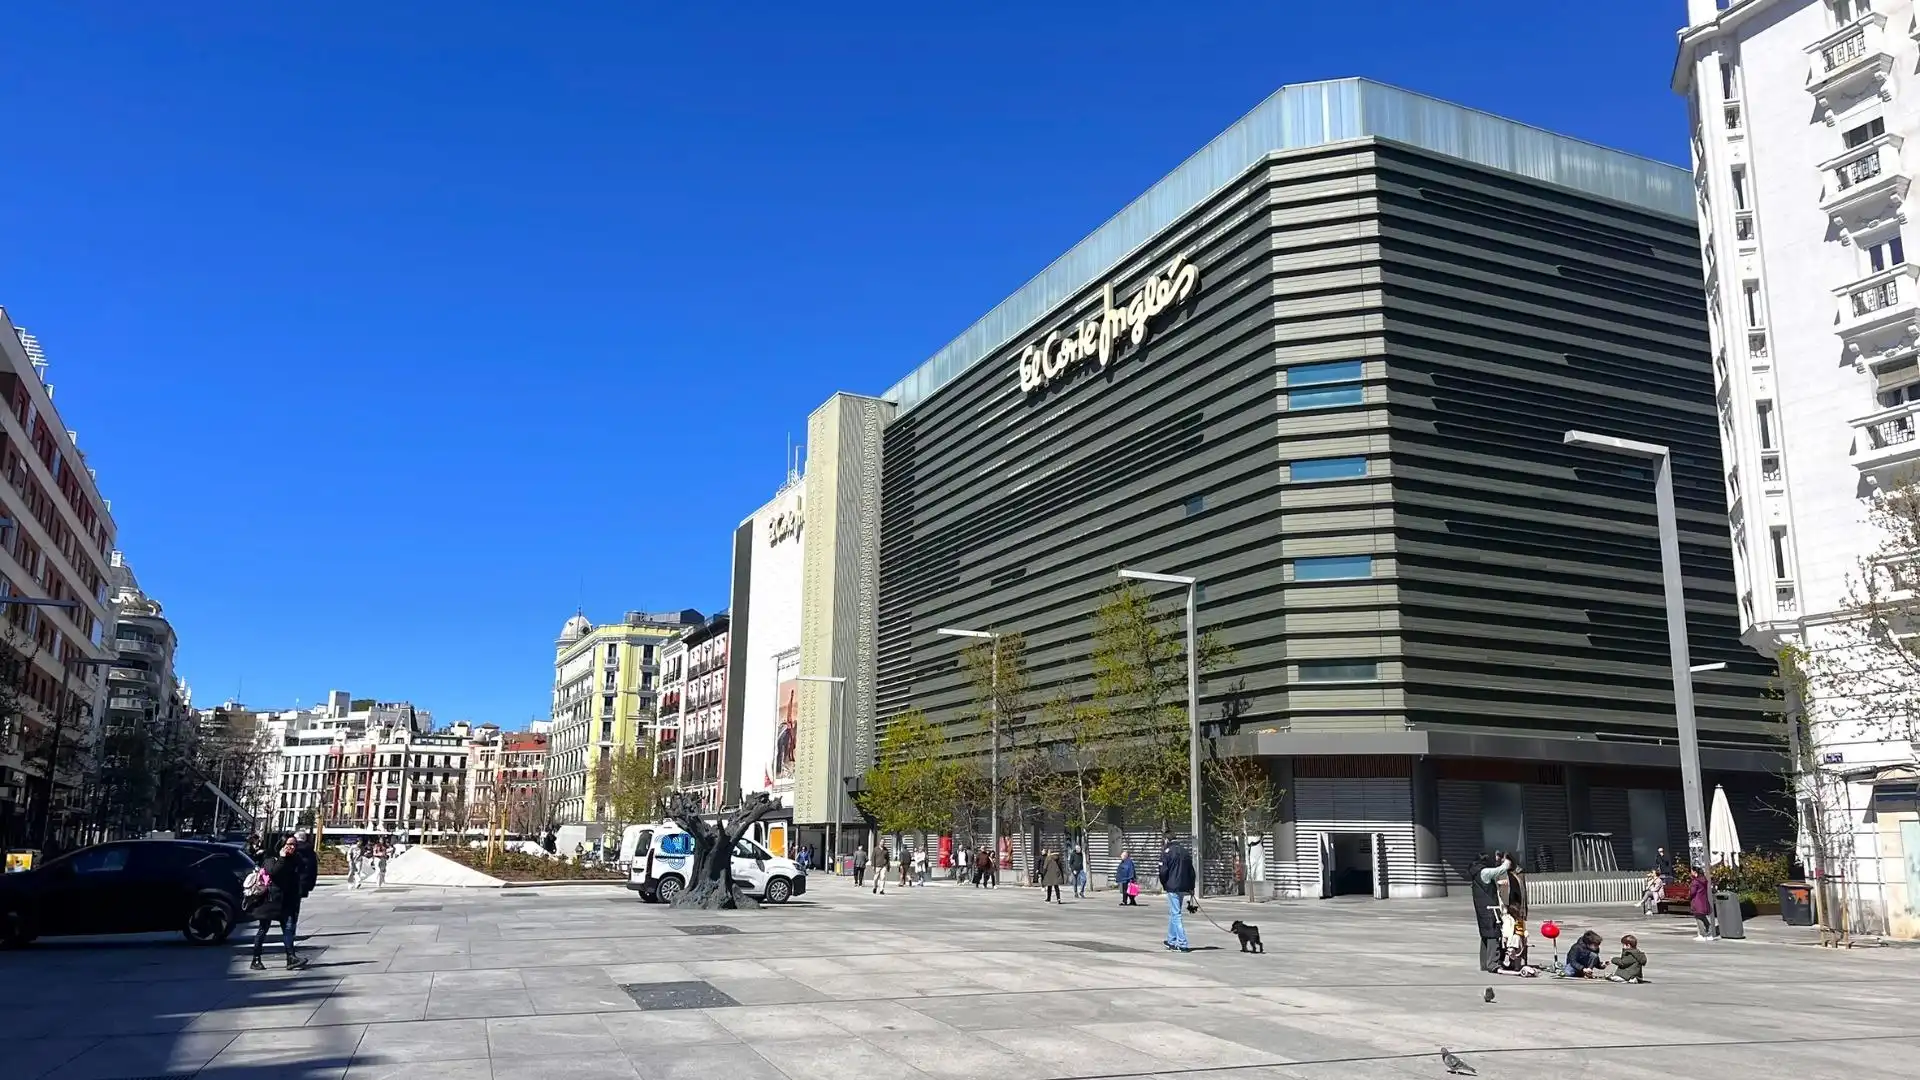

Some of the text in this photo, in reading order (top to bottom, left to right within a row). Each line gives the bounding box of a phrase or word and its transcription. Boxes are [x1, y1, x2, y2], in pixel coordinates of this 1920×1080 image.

[1020, 253, 1199, 392] El Corte Inglés
